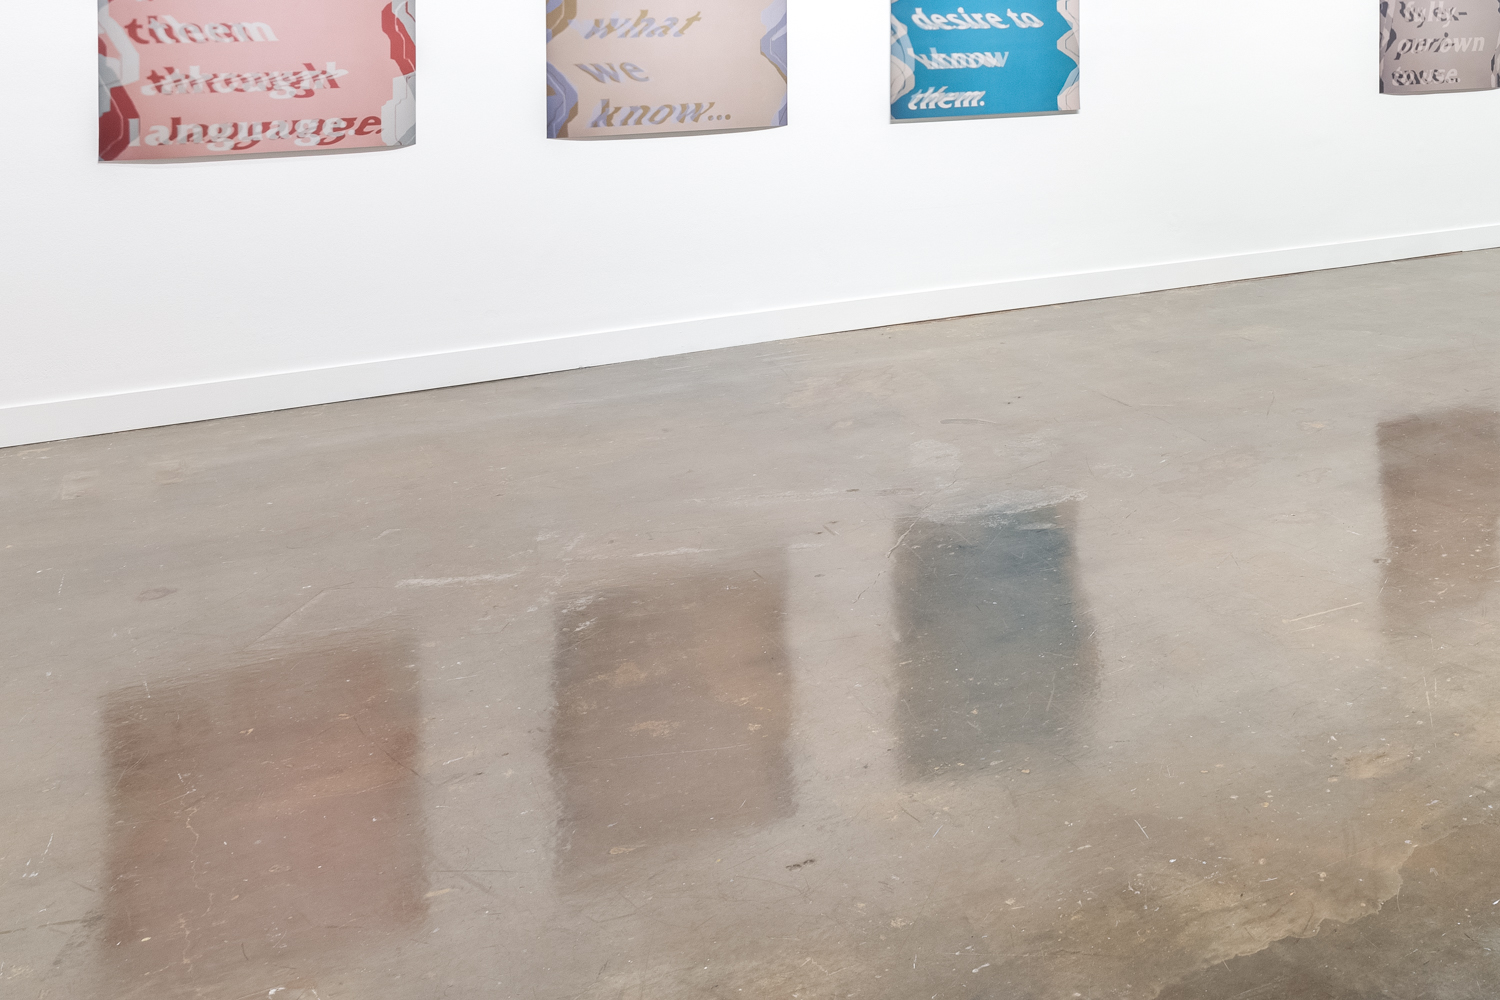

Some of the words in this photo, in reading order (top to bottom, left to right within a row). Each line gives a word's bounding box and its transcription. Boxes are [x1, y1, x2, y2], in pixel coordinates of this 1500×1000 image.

[125, 14, 279, 45] them
[567, 9, 702, 40] what
[911, 6, 1010, 31] desire
[1006, 8, 1044, 29] to
[573, 61, 650, 84] we
[907, 47, 1009, 70] know
[141, 62, 349, 99] through
[907, 86, 986, 111] them.
[586, 98, 731, 129] know...
